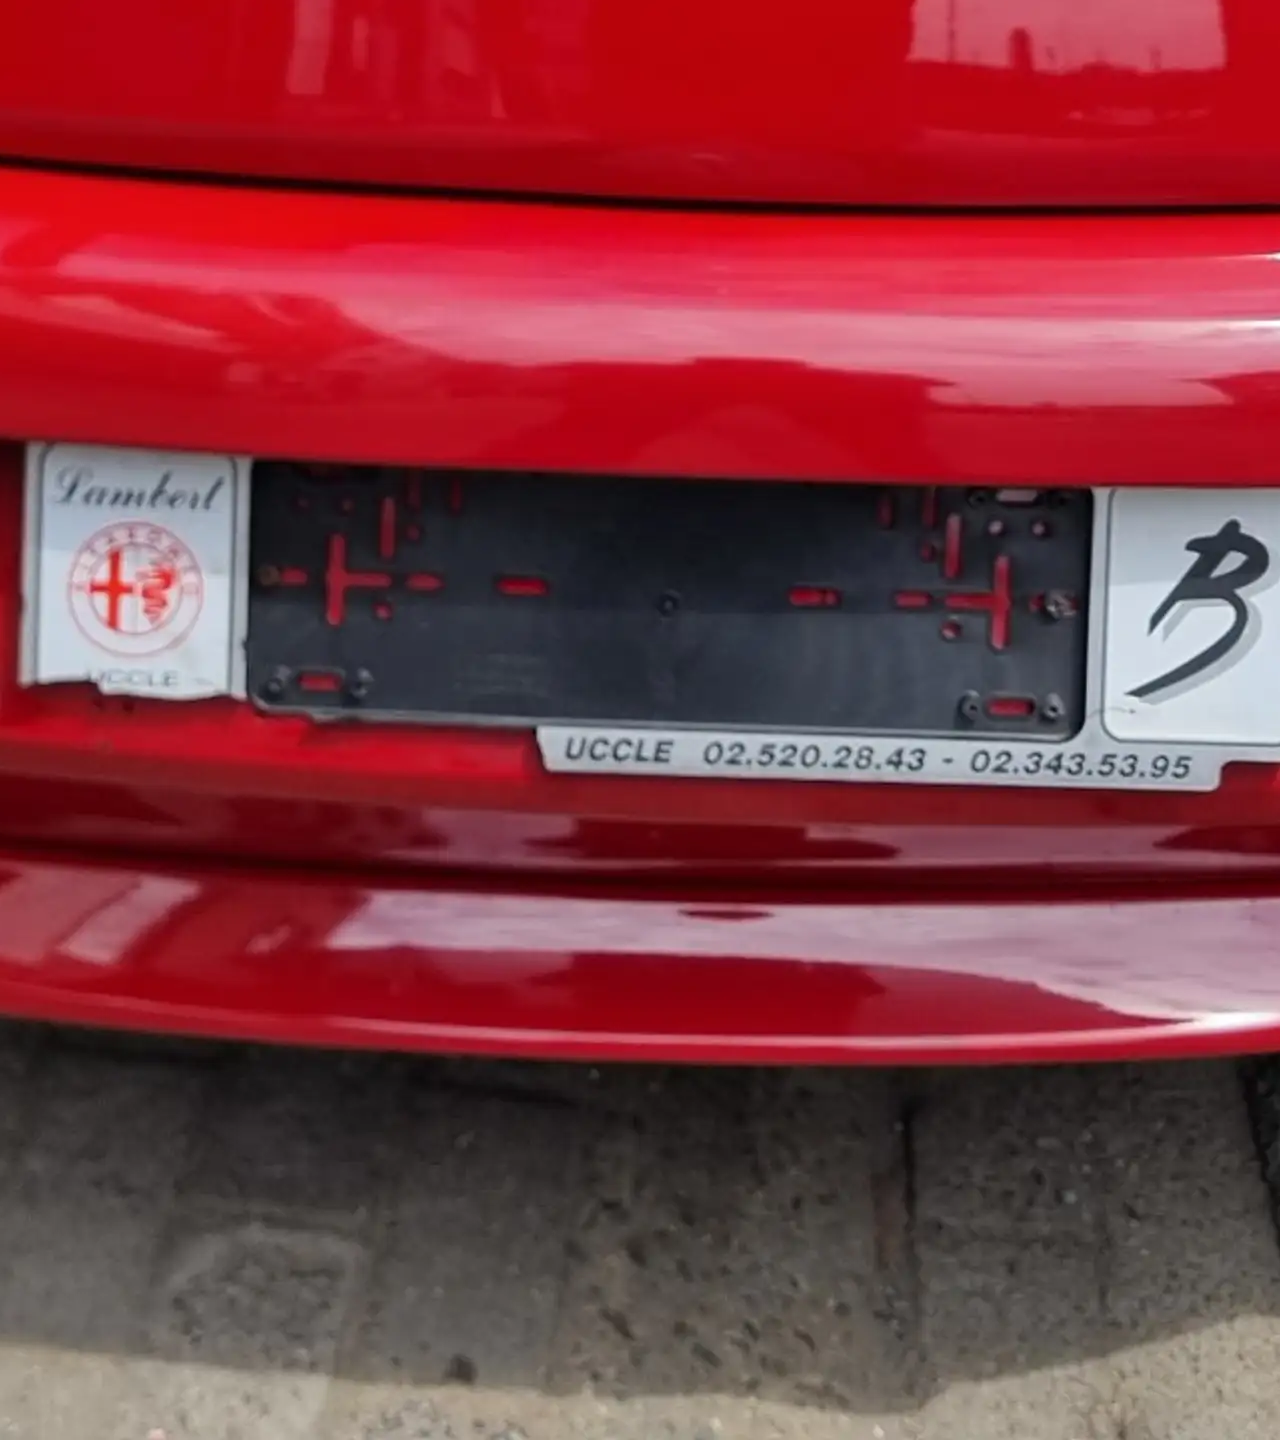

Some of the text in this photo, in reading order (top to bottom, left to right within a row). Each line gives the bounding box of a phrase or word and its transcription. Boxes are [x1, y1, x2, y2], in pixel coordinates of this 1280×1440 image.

[53, 465, 225, 510] Lambert
[564, 737, 674, 764] UCCLE
[703, 740, 926, 772] 02.520.28.43
[971, 749, 1193, 780] 02.343.53.95
